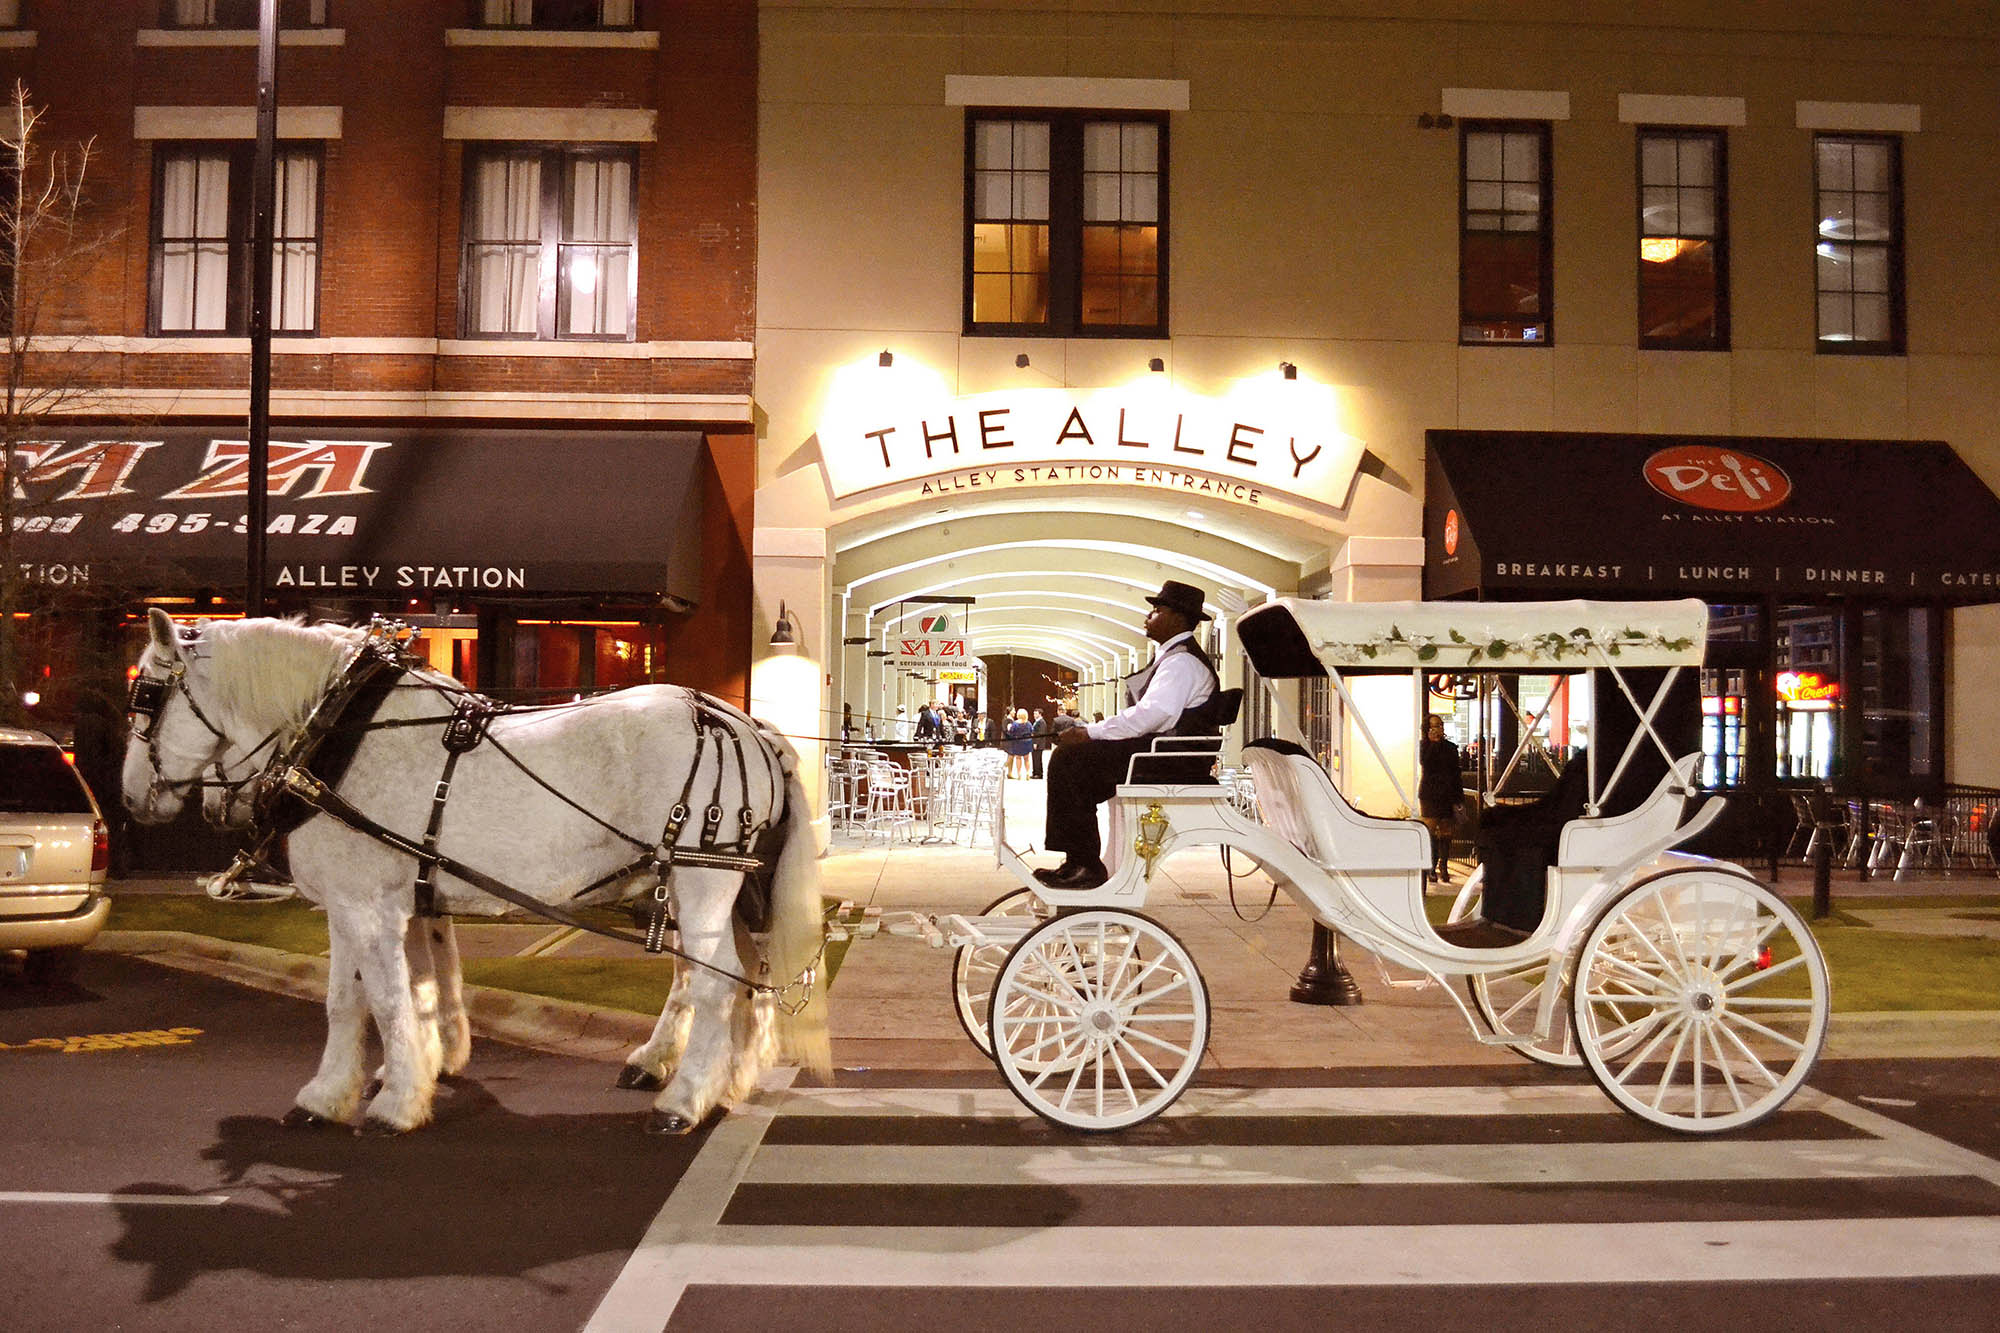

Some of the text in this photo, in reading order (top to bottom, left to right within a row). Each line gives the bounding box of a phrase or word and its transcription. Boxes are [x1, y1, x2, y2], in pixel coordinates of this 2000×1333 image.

[864, 405, 1322, 478] THE ALLEY
[921, 465, 1263, 503] ALLEY STATION ENTRANCE
[1656, 454, 1772, 500] Deli
[1661, 513, 1836, 525] AT ALLEY STATION
[276, 565, 526, 588] ALLEY STATION
[1496, 562, 1622, 579] BREAKFAST
[1679, 566, 1750, 580] LUNCH
[1805, 567, 1886, 584] DINNER
[899, 660, 968, 668] serious italian food
